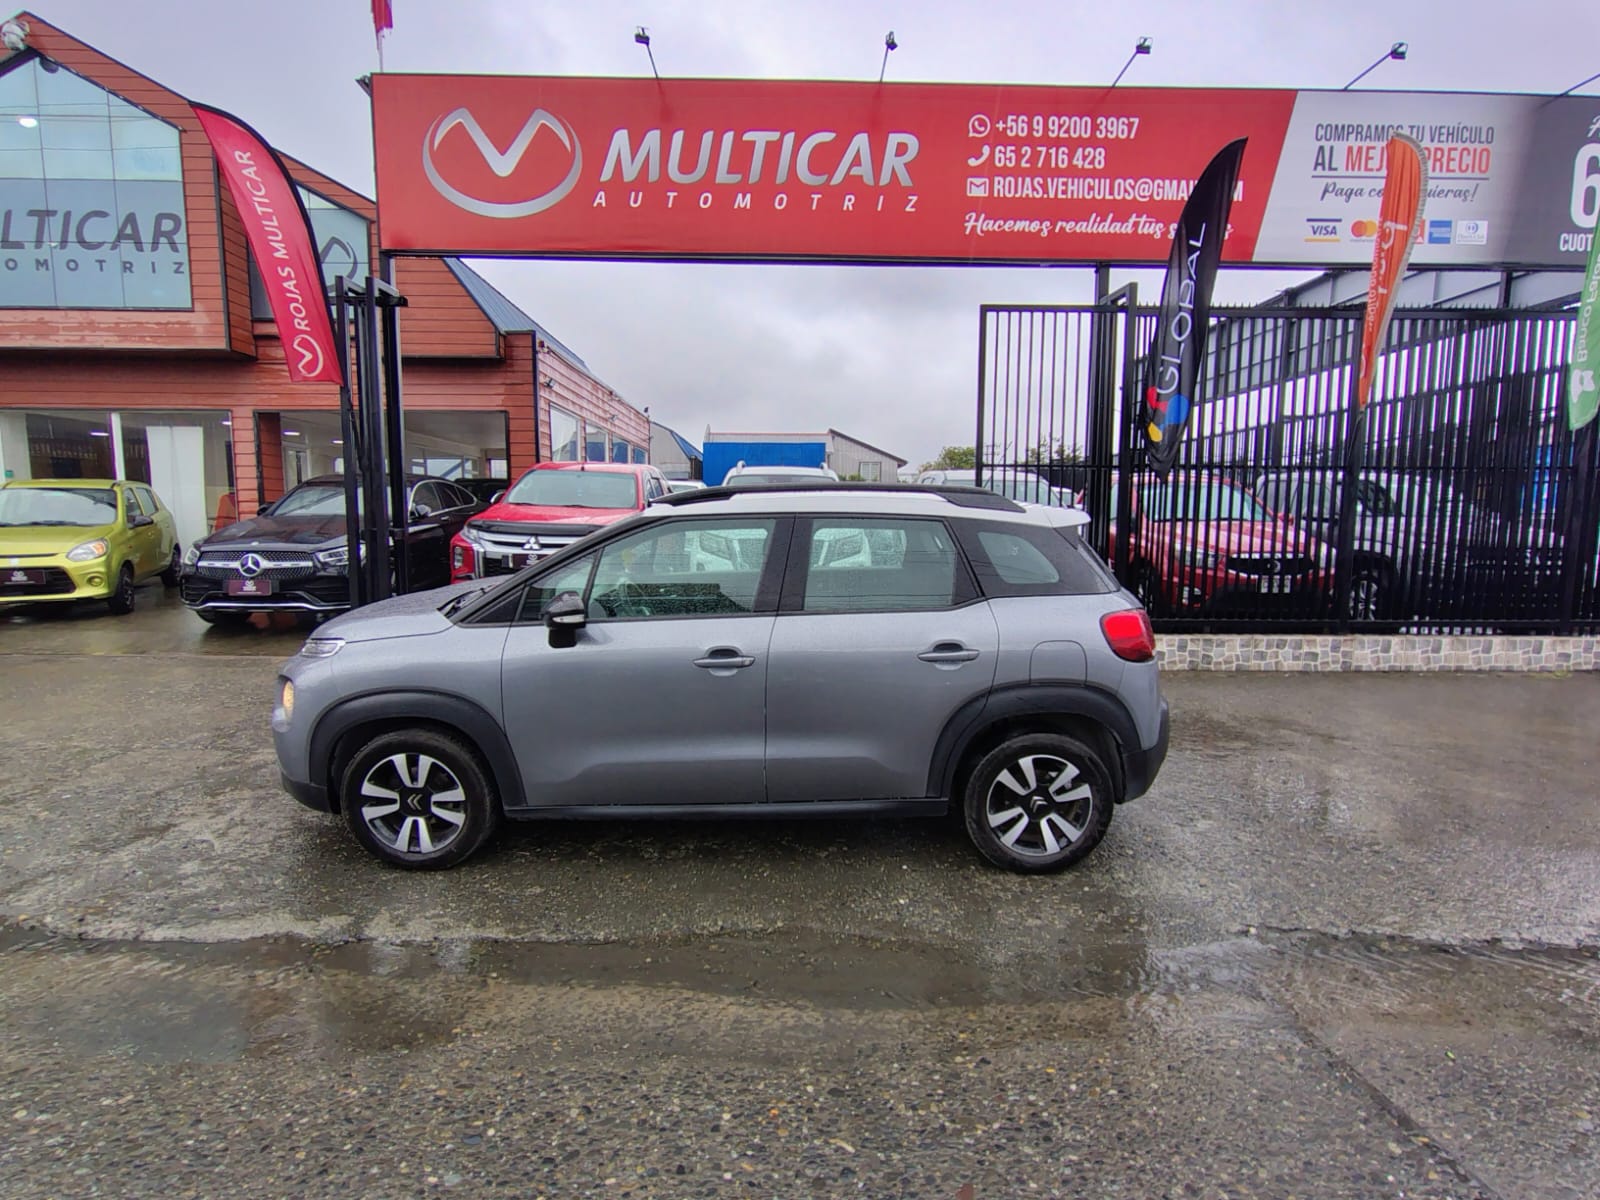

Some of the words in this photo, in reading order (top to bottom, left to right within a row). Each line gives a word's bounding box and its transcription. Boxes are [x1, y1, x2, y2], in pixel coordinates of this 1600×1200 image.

[995, 115, 1028, 137] +56
[1033, 115, 1044, 137] 9
[1048, 115, 1091, 138] 9200
[1096, 117, 1139, 139] 3967
[1408, 125, 1425, 143] TU
[1429, 121, 1495, 144] VEHÍCULO
[600, 128, 919, 187] MULTICAR
[994, 145, 1016, 167] 65
[1021, 146, 1032, 167] 2
[1036, 146, 1069, 168] 716
[1072, 147, 1106, 169] 428
[1313, 145, 1338, 171] AL
[1345, 145, 1386, 172] MEJ
[234, 150, 289, 260] MULTICAR
[593, 191, 918, 212] AUTOMOTRIZ
[964, 212, 1053, 237] Hacemos
[1055, 212, 1135, 234] realidad
[1134, 214, 1167, 239] tus
[1311, 225, 1337, 236] VISA
[1559, 233, 1594, 252] CUOT
[276, 266, 311, 331] ROJAS
[1156, 222, 1206, 395] GLOBAL
